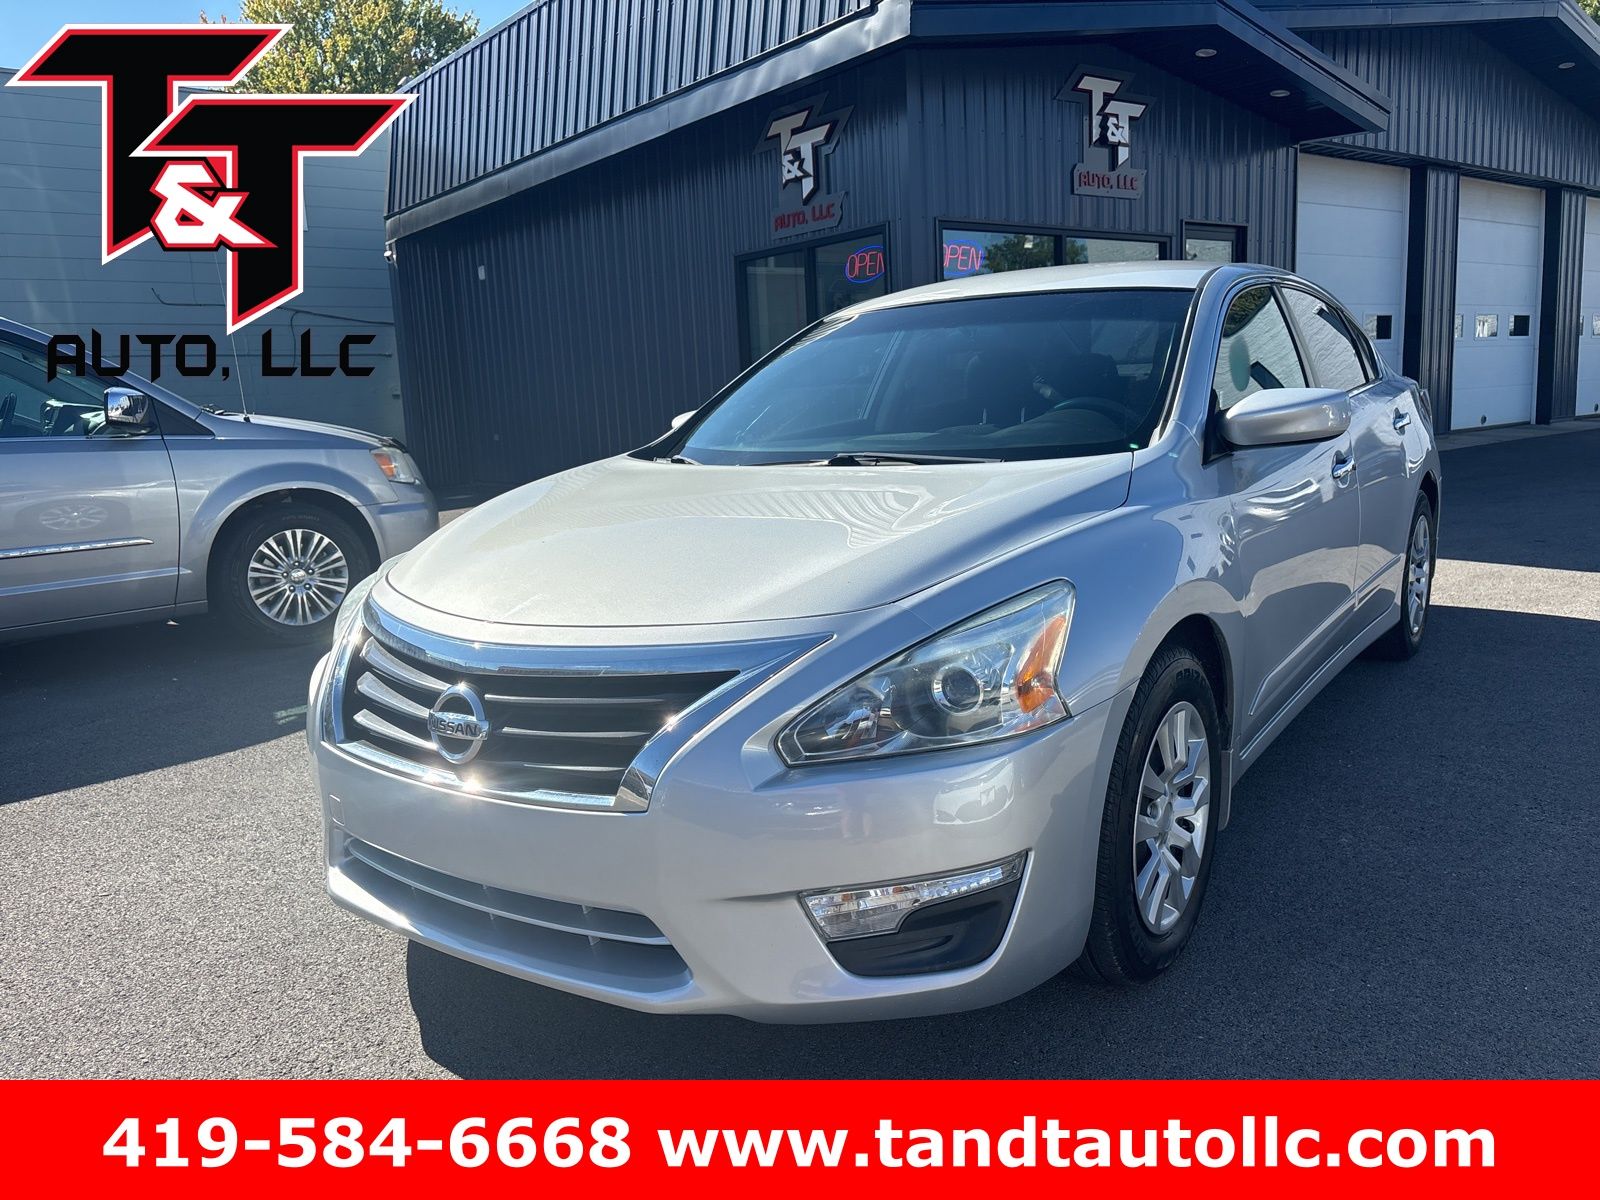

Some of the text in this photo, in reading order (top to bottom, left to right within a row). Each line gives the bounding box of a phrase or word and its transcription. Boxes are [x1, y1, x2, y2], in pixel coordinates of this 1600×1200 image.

[1072, 73, 1148, 167] T&T
[1078, 171, 1138, 190] AUTO, LLC
[774, 202, 836, 232] AUTO, LLC
[430, 713, 478, 737] NISSAN
